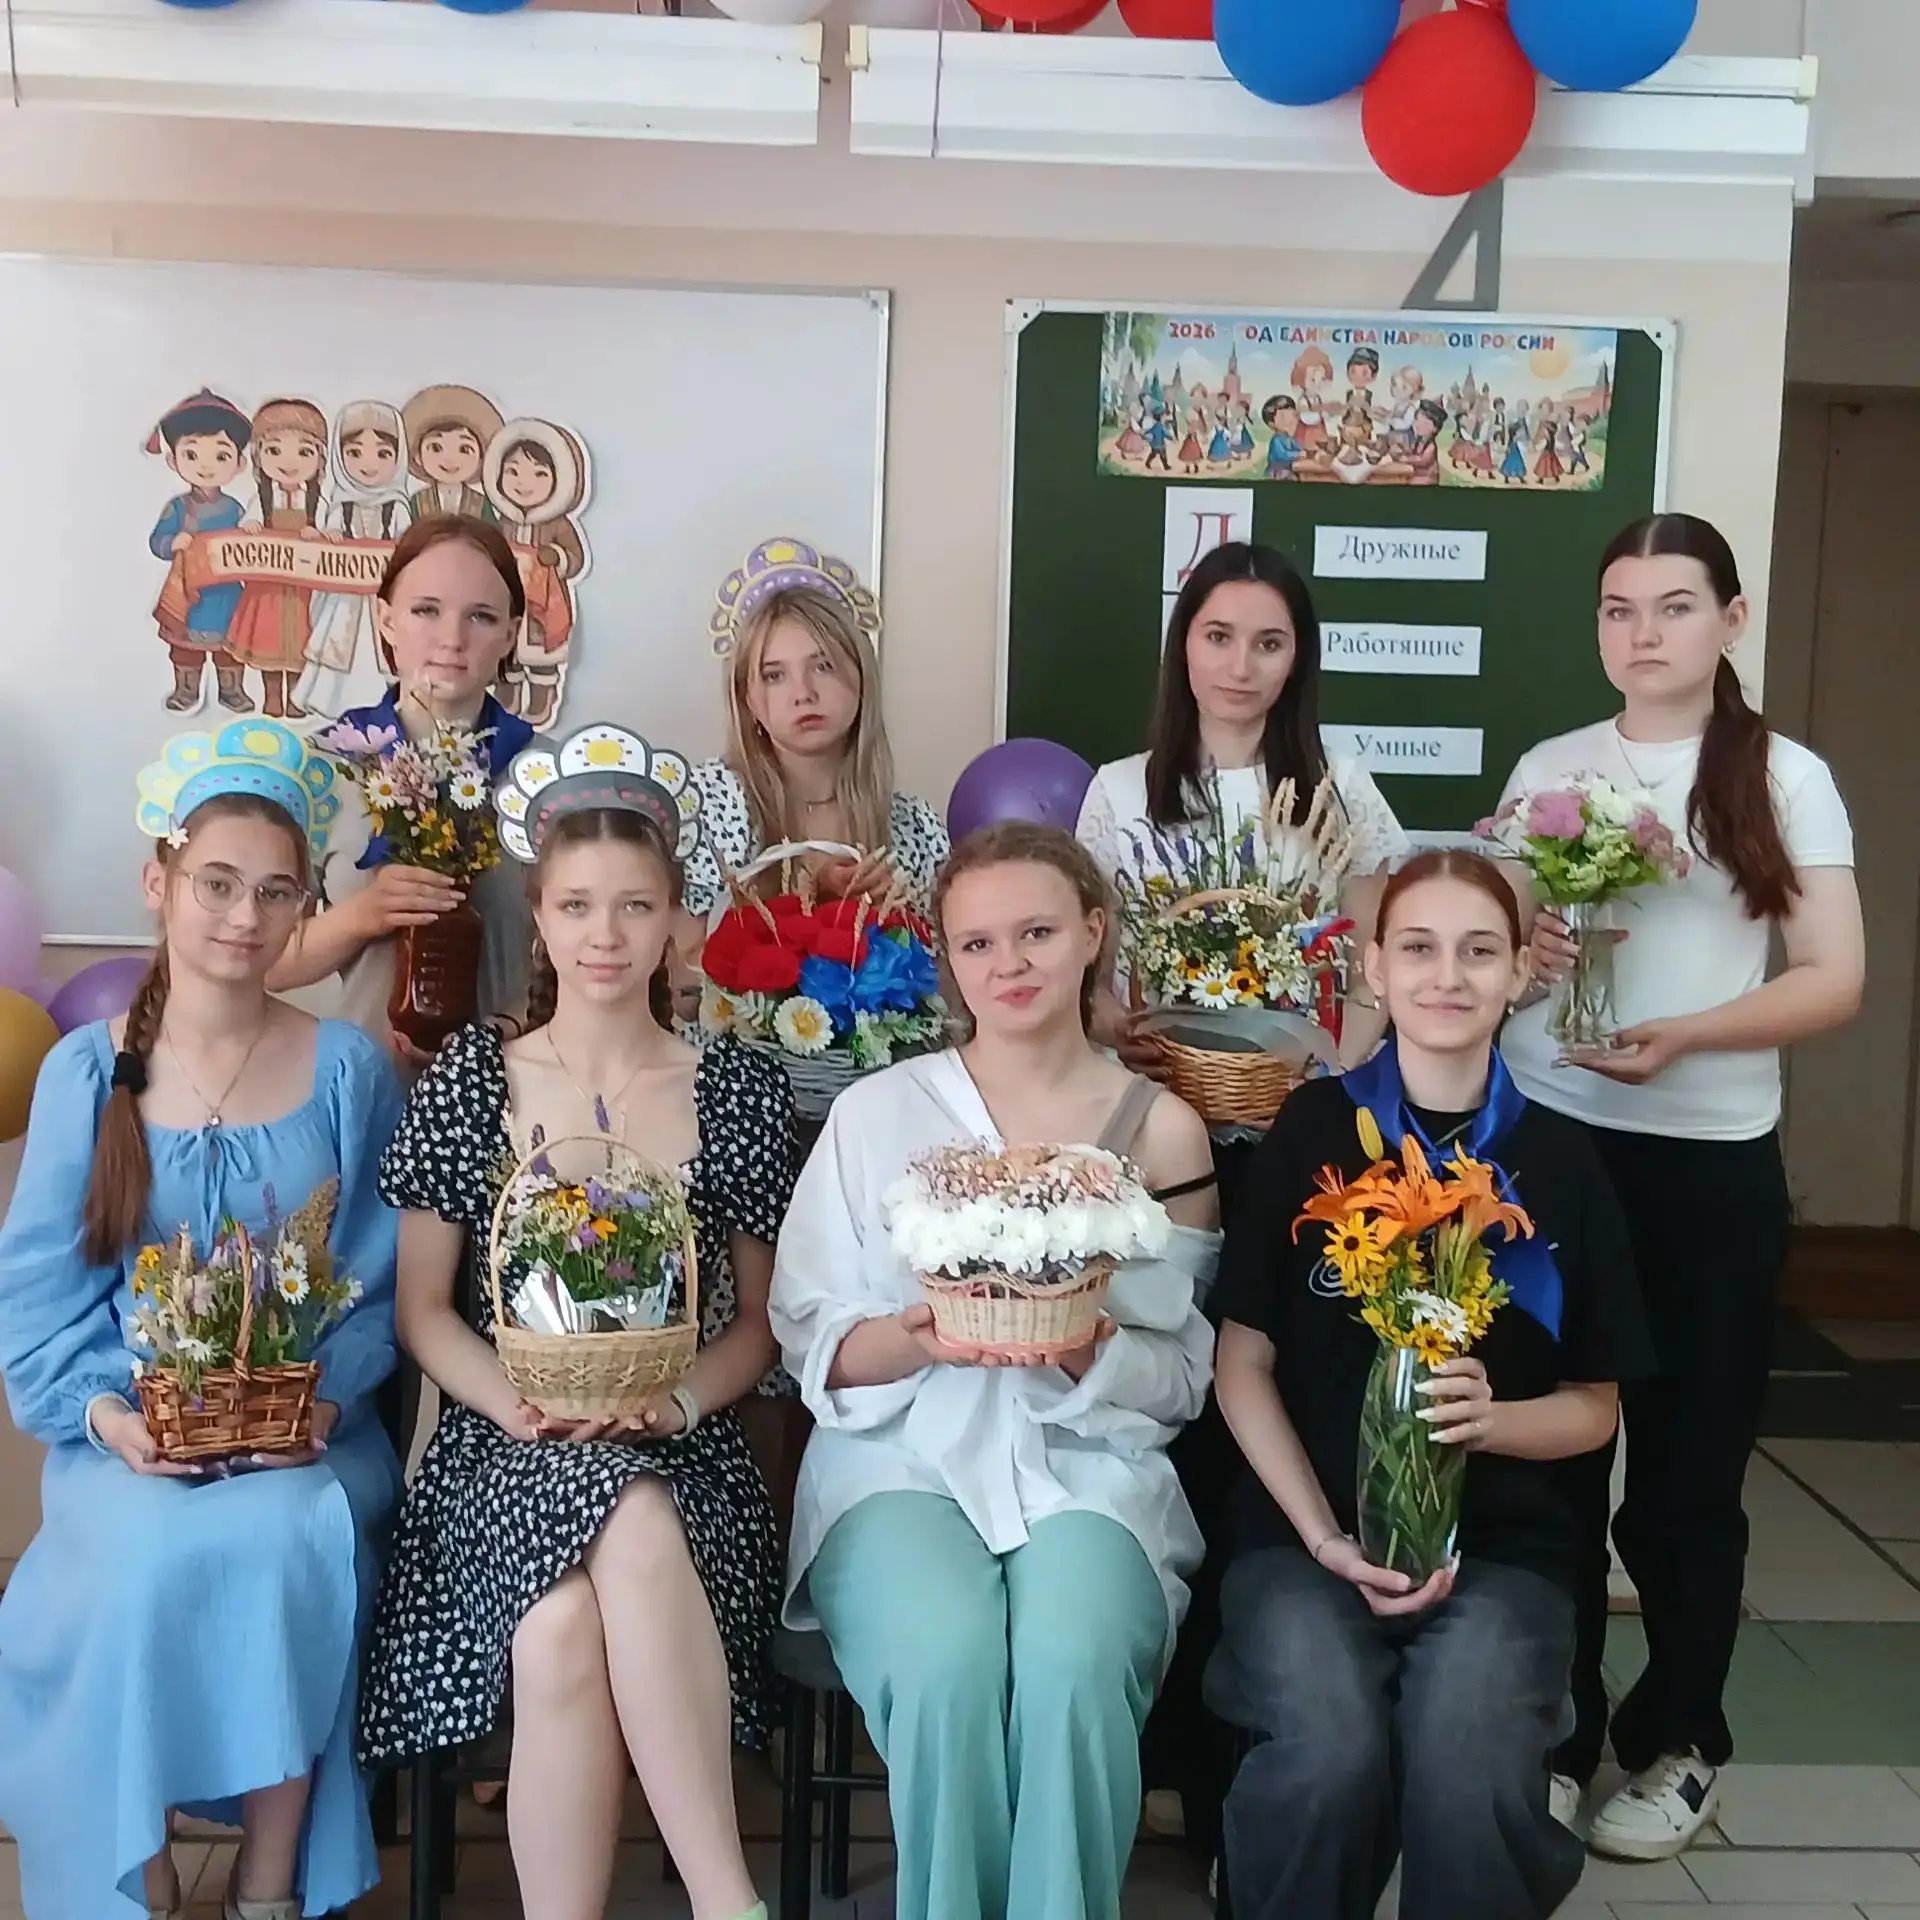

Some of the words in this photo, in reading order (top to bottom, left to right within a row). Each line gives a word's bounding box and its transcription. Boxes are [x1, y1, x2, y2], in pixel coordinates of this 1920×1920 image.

[1168, 321, 1216, 339] 2026
[1235, 323, 1273, 343] ОД
[221, 542, 295, 572] РОССИЯ
[1338, 534, 1461, 563] Дружные
[1327, 631, 1464, 657] Работящие
[1354, 734, 1442, 758] Умные
